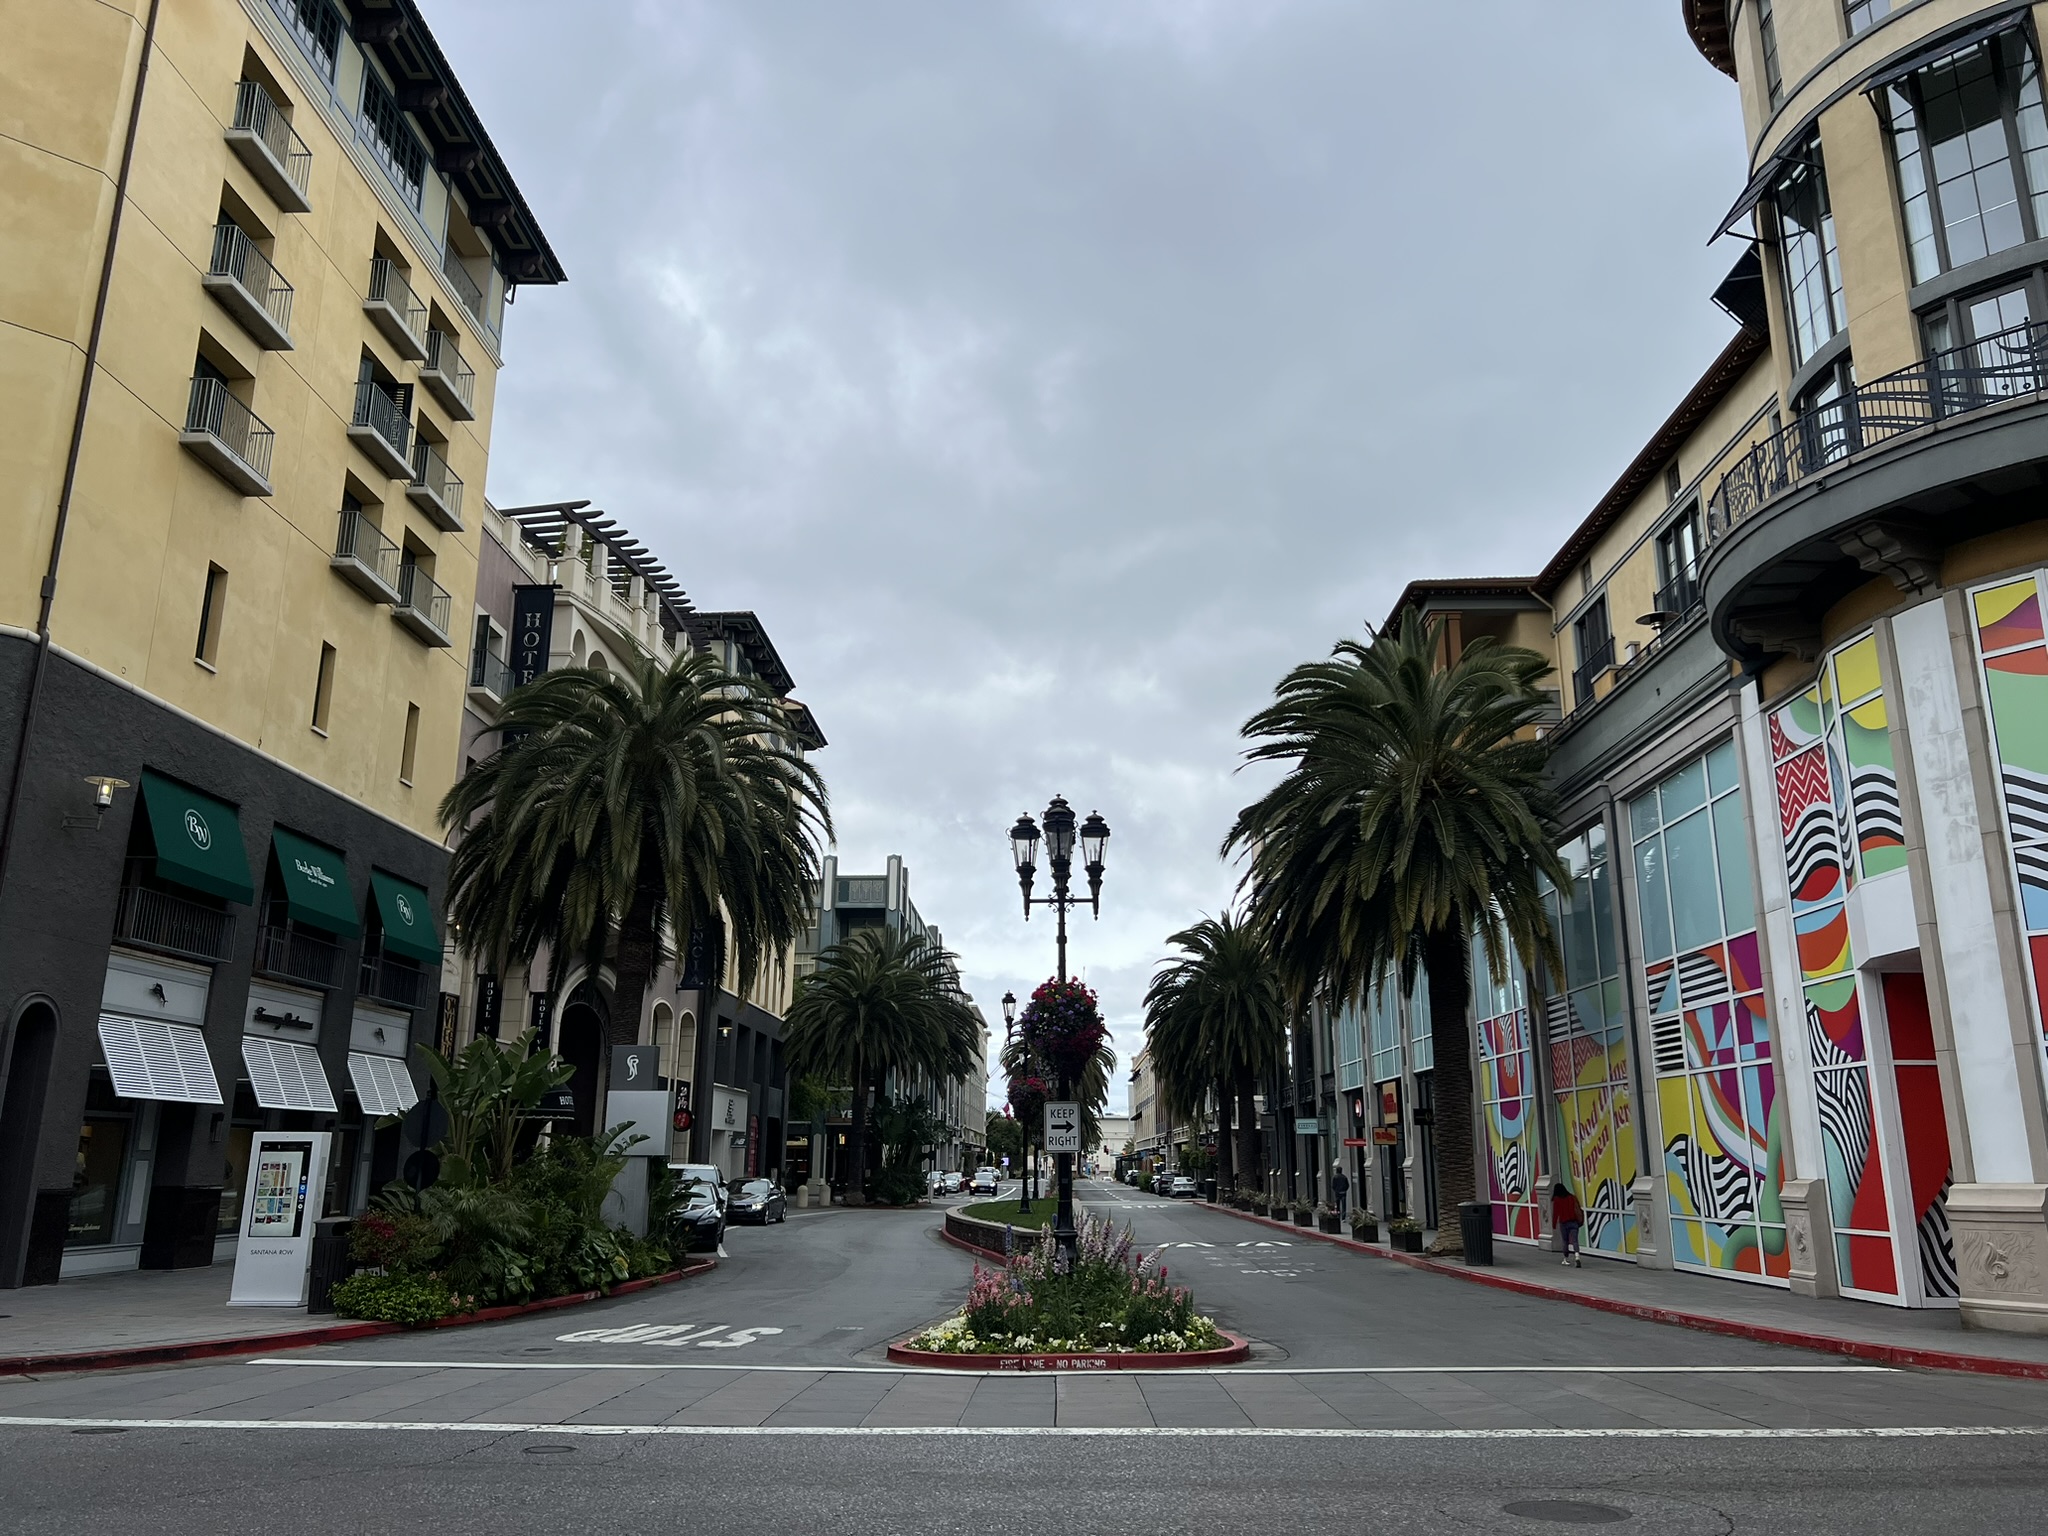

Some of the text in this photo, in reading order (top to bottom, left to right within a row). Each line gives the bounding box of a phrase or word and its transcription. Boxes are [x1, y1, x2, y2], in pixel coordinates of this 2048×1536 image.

[522, 612, 542, 687] HOTE
[485, 981, 494, 1018] HOTEL
[538, 998, 546, 1032] HOTEL
[1050, 1108, 1075, 1118] KEEP
[1608, 1103, 1631, 1129] her
[1048, 1136, 1077, 1146] RIGHT
[555, 1323, 783, 1348] STOP
[1056, 1359, 1069, 1369] NO
[1071, 1359, 1107, 1369] PARKING
